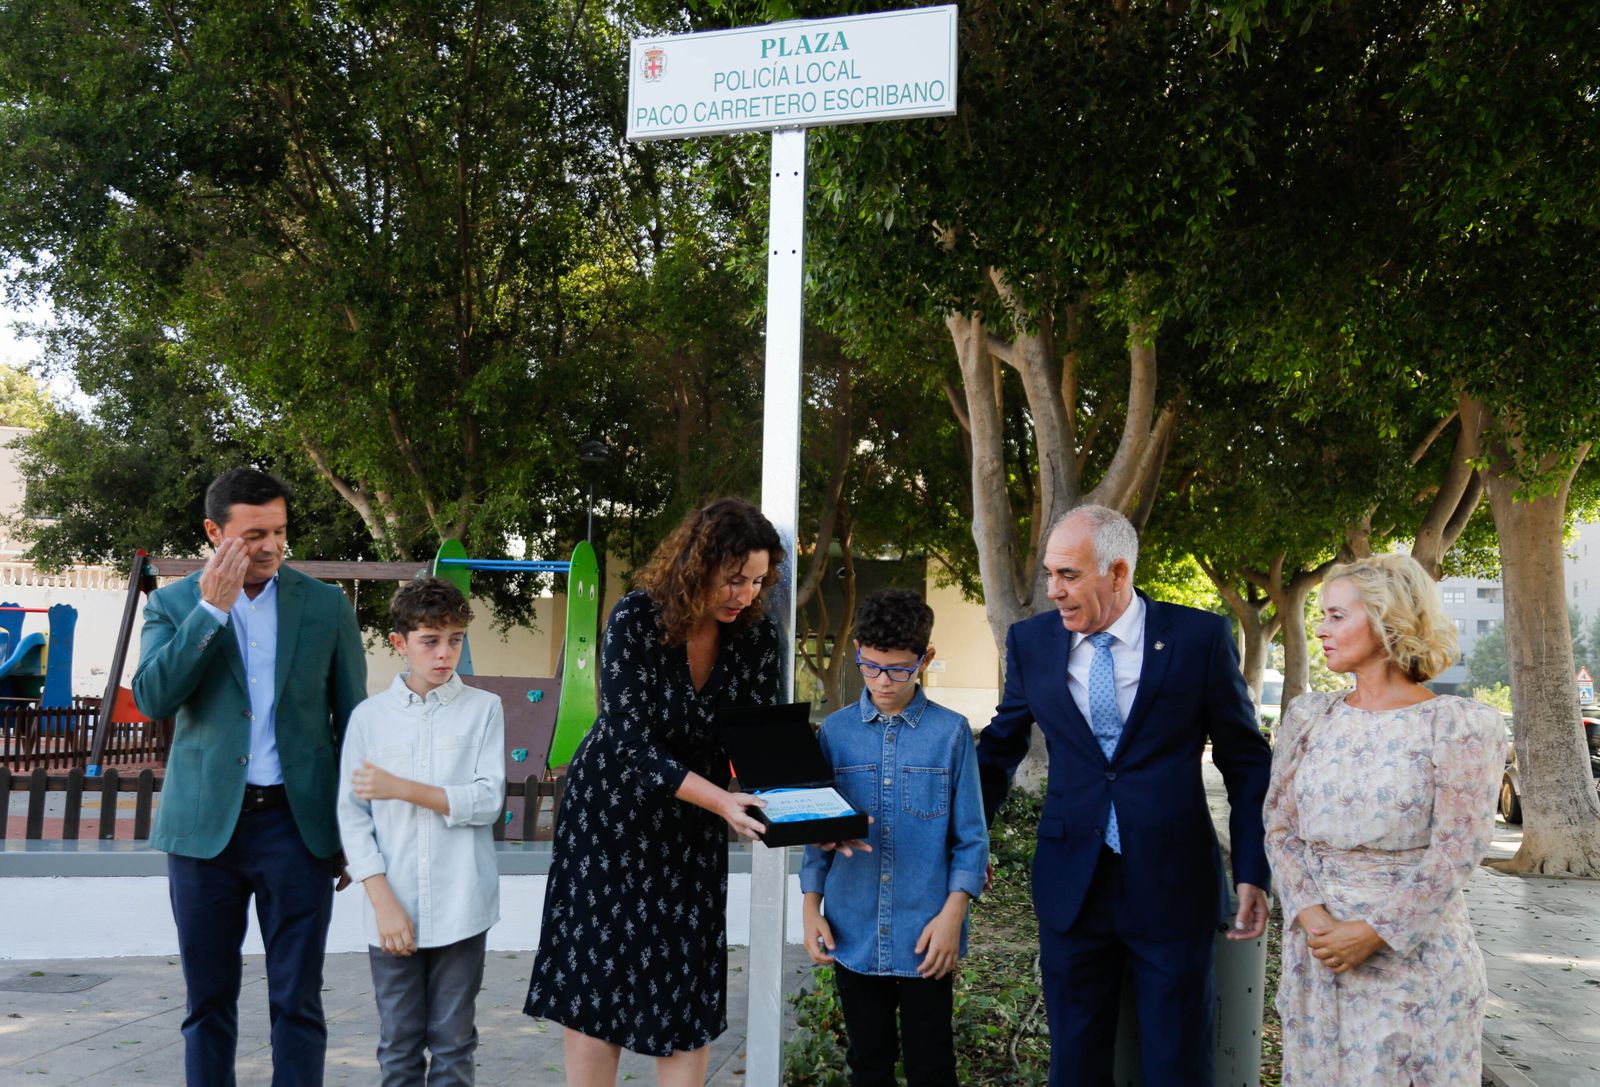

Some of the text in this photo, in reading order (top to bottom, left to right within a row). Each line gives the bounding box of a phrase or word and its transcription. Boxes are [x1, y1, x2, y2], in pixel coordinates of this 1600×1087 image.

[760, 31, 849, 59] PLAZA
[714, 59, 861, 92] POLICÍA LOCAL
[636, 79, 945, 127] PACO CARRETERO ESCRIBANO
